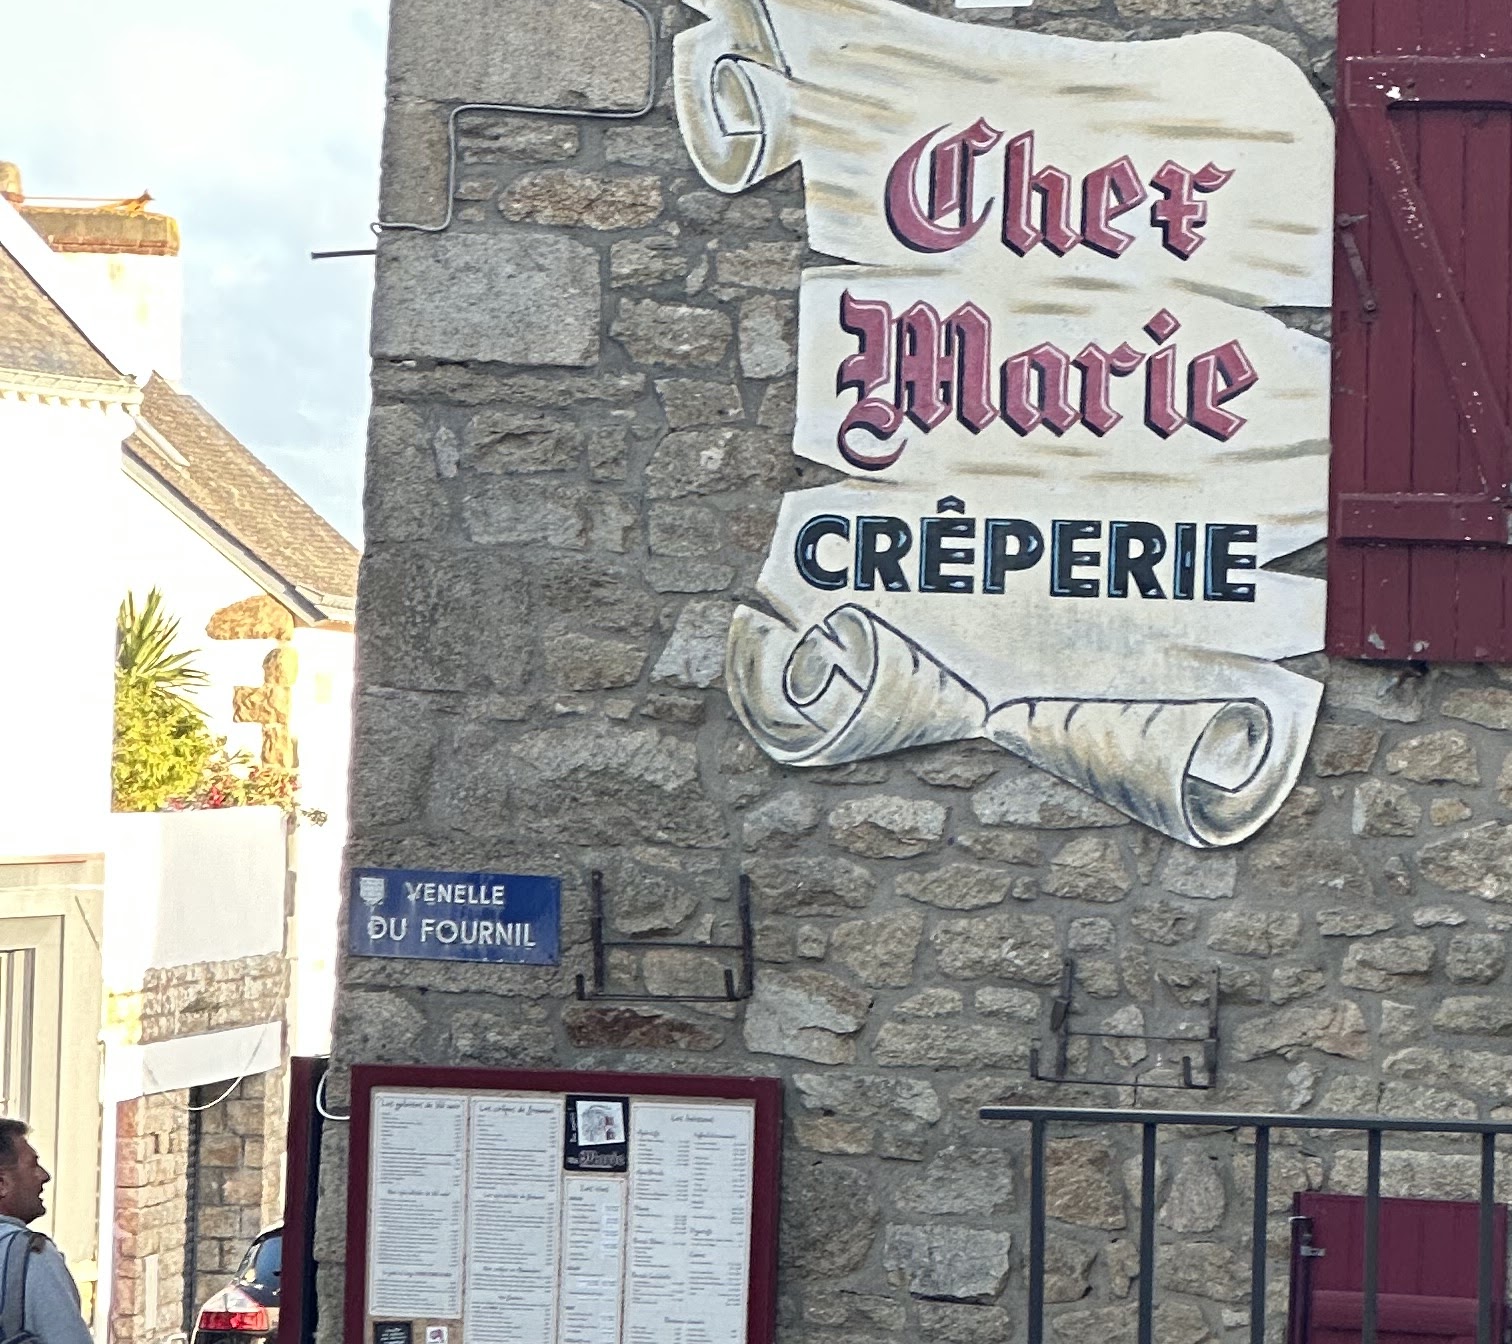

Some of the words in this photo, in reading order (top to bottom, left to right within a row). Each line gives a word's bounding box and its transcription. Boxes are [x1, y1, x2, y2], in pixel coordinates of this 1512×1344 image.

[835, 288, 1259, 471] Marie
[794, 495, 1259, 602] CRÊPERIE
[404, 882, 505, 906] VENELLE
[367, 915, 407, 941] DU
[420, 918, 537, 949] FOURNIL
